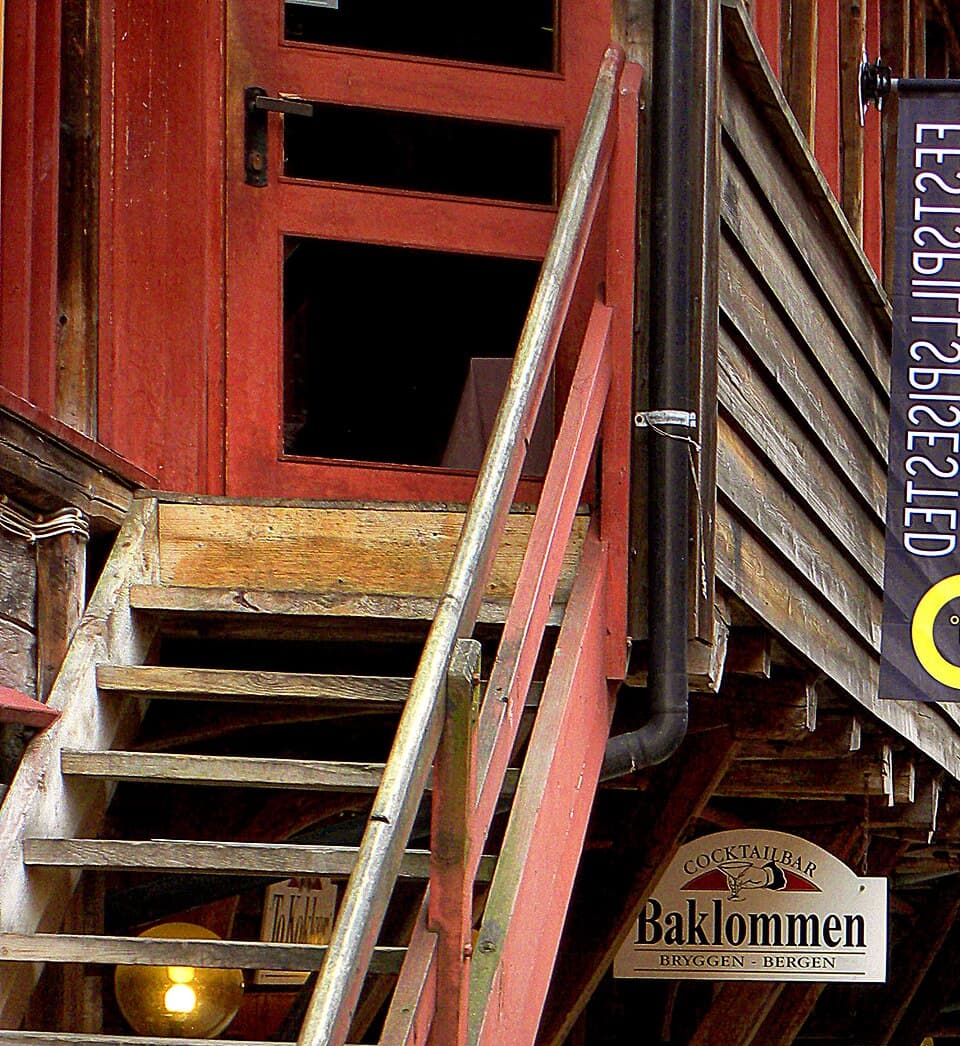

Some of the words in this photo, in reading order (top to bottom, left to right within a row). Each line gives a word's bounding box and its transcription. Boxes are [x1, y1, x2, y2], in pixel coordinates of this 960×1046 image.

[683, 844, 817, 878] COCKTAILBAR
[633, 898, 867, 948] Baklommen
[659, 955, 745, 968] BRYGGEN
[763, 956, 836, 969] BERGEN
